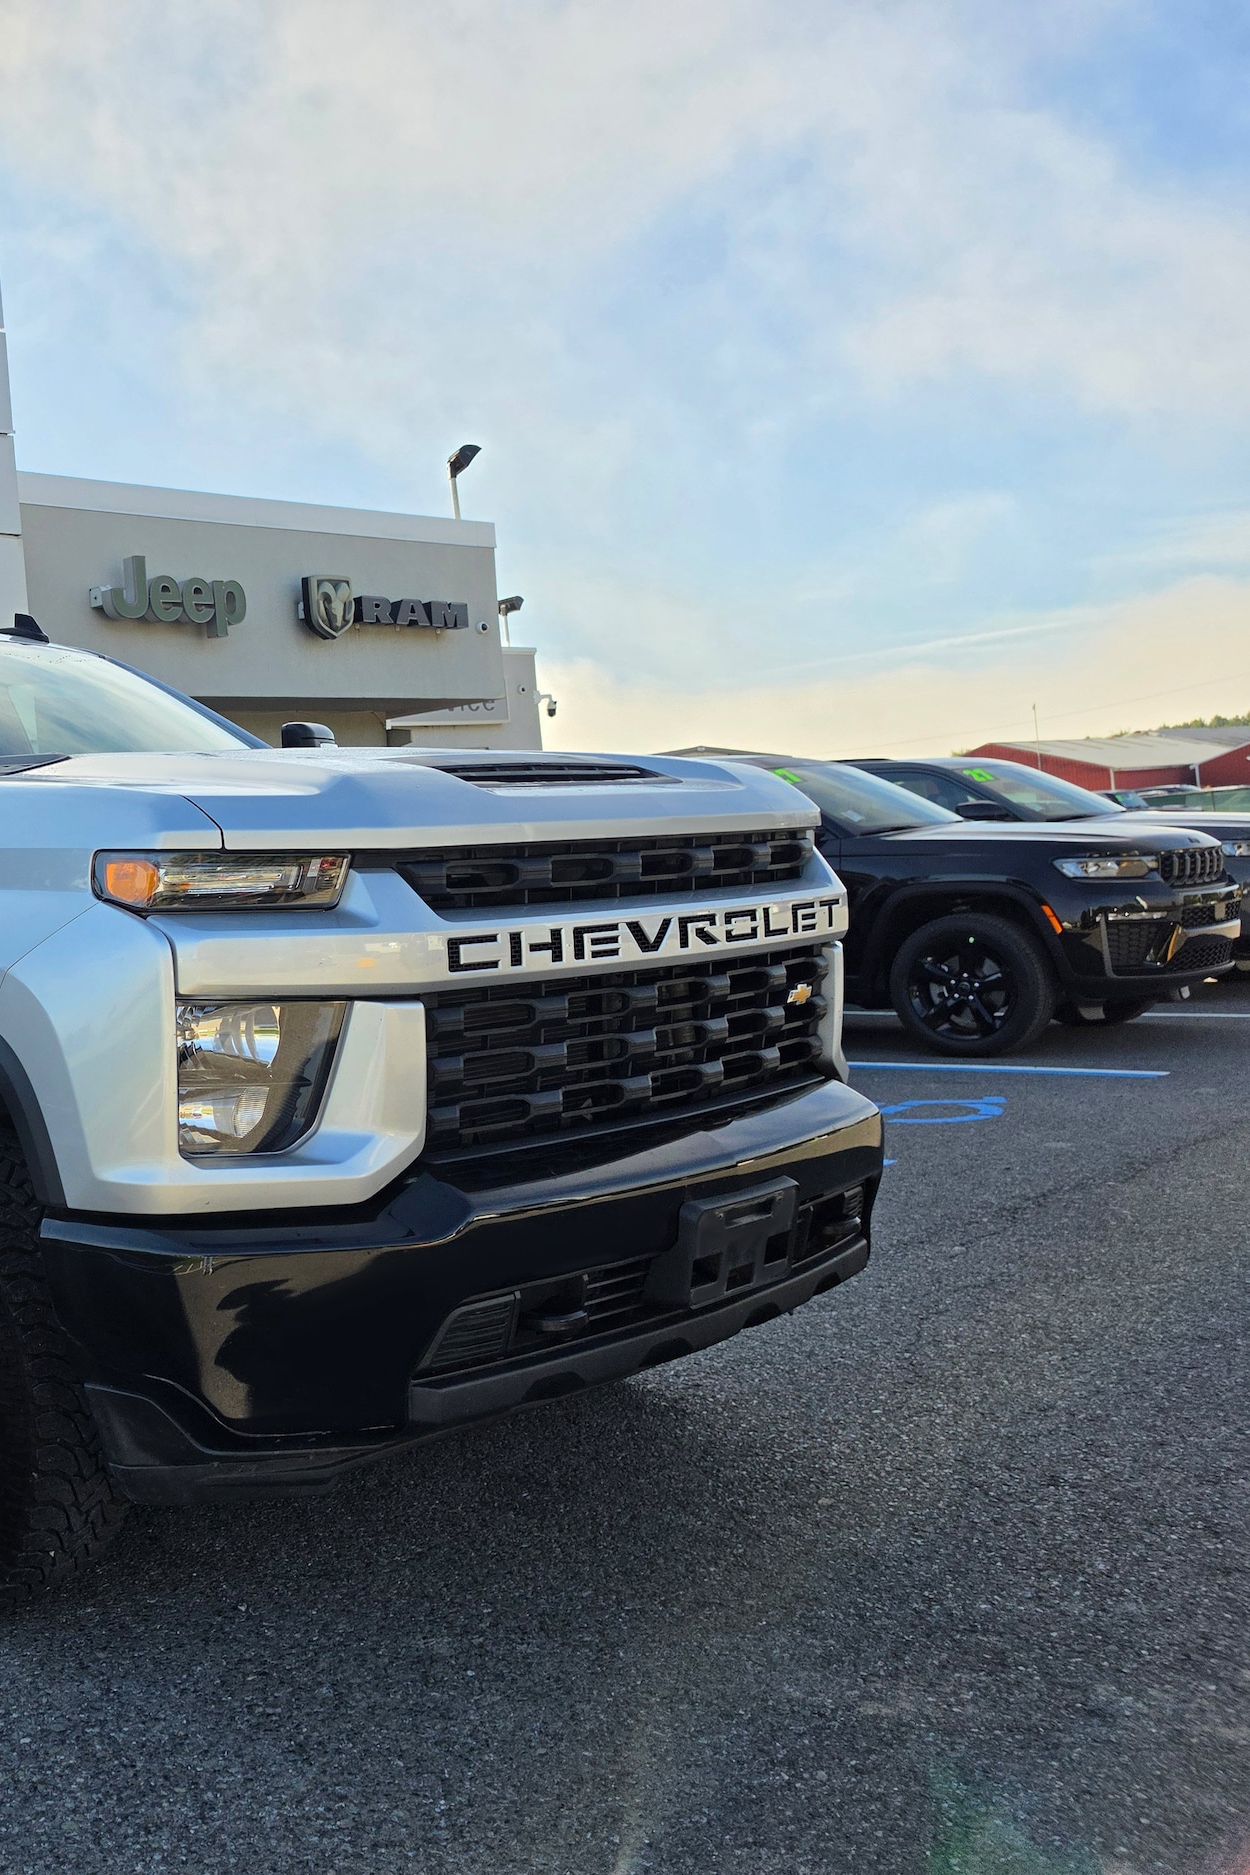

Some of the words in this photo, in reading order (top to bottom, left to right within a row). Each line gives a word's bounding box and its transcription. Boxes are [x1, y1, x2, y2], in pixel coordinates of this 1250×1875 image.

[104, 555, 247, 639] Jeep
[357, 595, 469, 629] RAM
[447, 898, 840, 973] CHEVROLET
